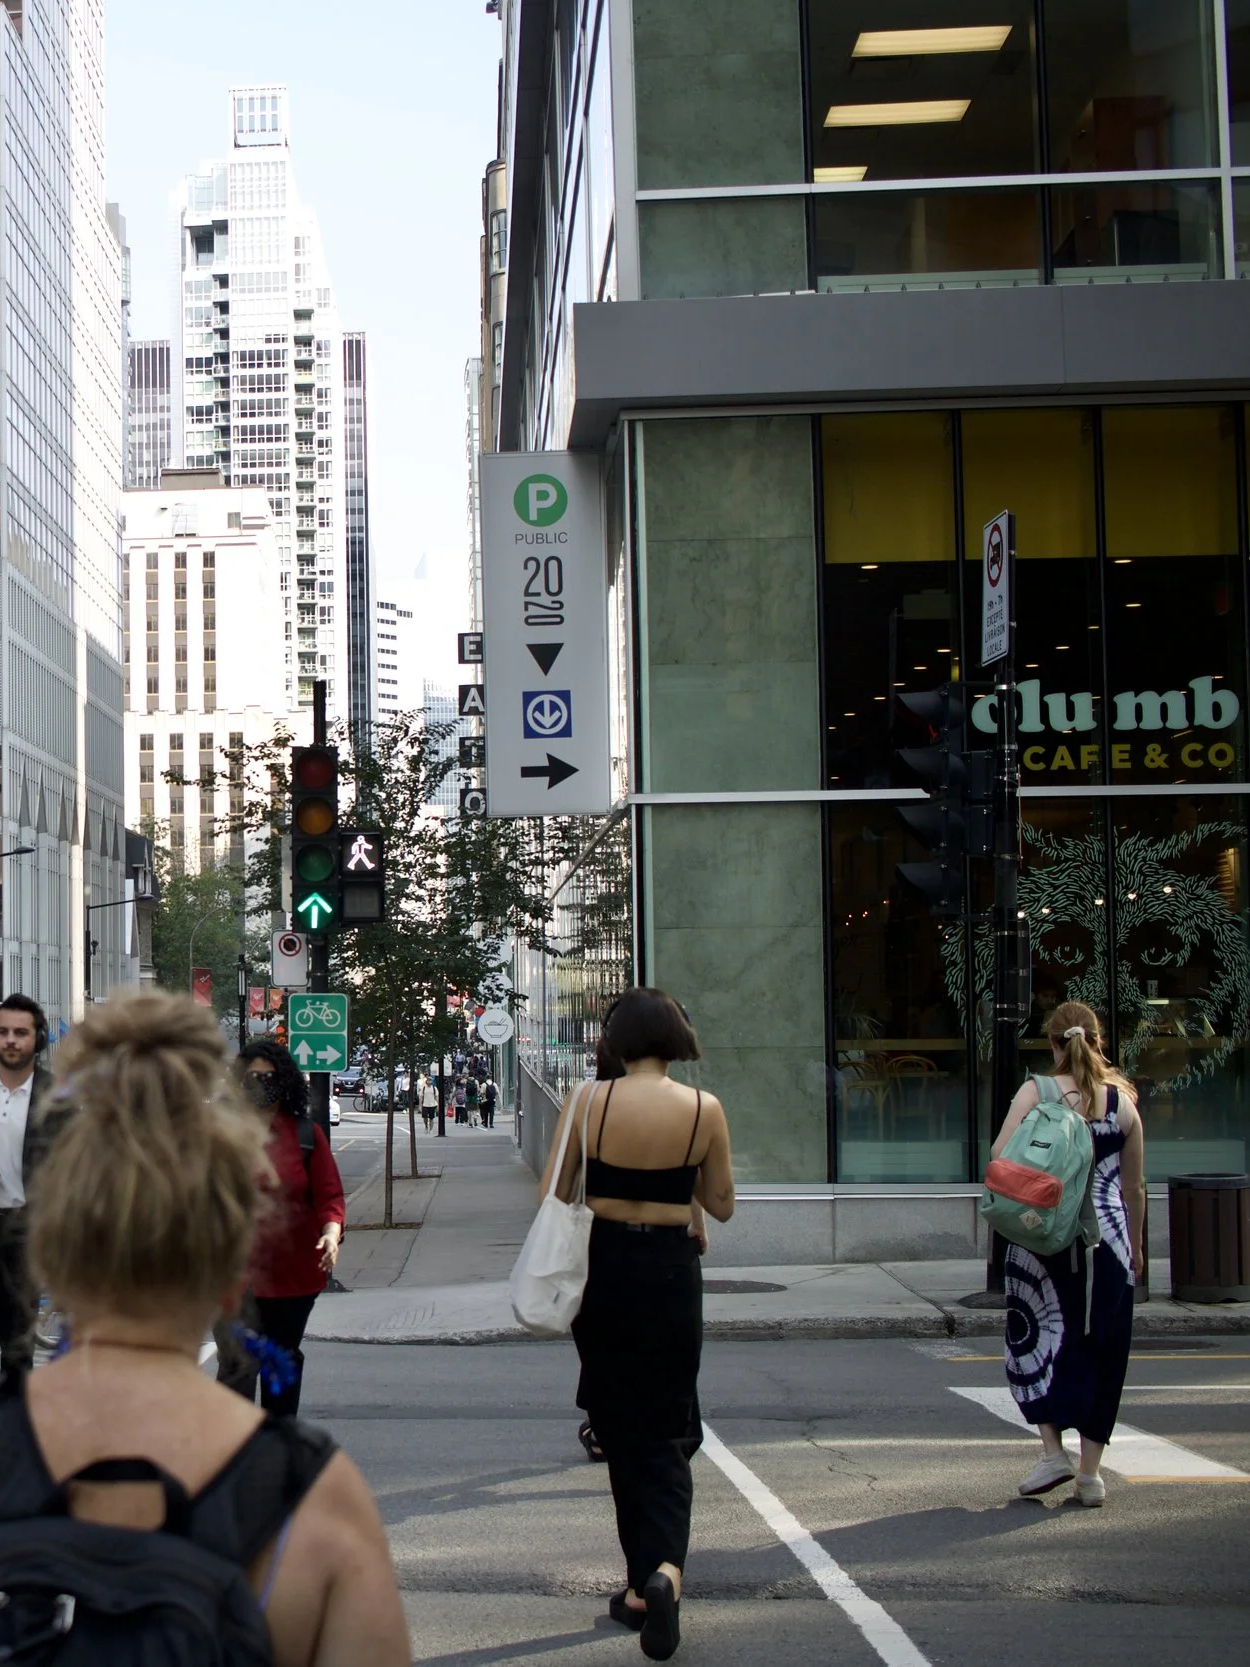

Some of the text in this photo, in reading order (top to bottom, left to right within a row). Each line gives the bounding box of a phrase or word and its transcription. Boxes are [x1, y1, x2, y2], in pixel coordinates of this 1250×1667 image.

[528, 482, 558, 521] P
[515, 531, 568, 545] PUBLIC
[523, 555, 563, 597] 20
[1144, 743, 1169, 769] &
[1181, 742, 1235, 768] CO
